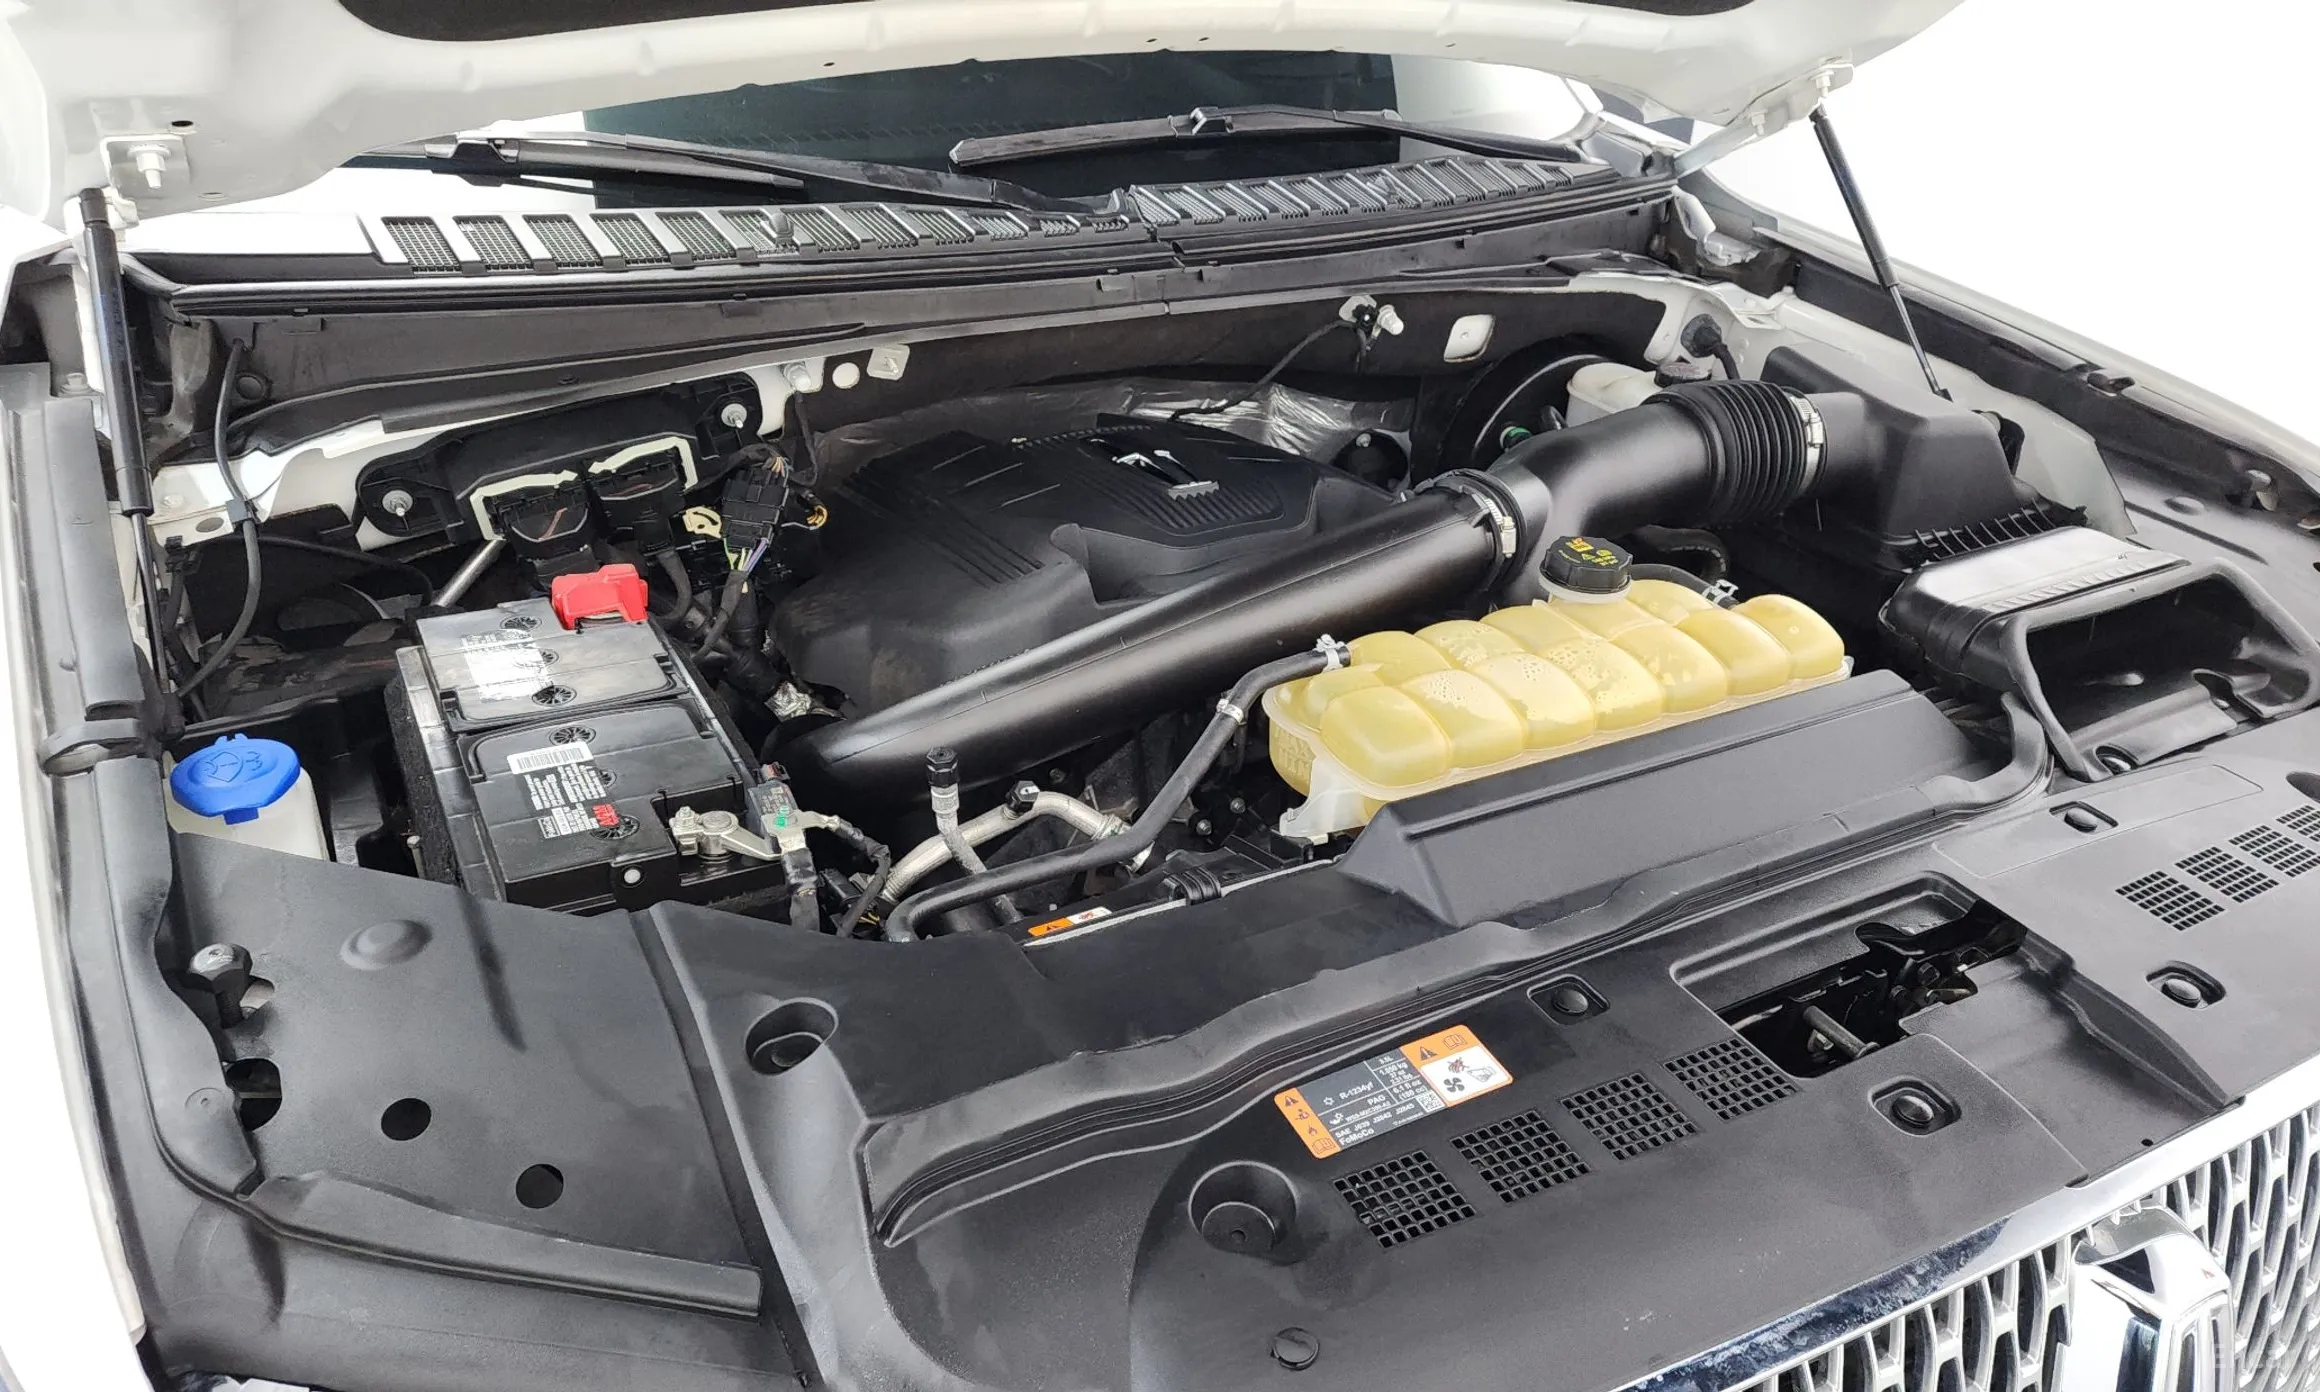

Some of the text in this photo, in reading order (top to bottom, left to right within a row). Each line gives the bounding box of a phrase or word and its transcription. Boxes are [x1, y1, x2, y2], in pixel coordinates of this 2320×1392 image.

[1396, 1062, 1408, 1070] kg
[1339, 1081, 1374, 1100] R-1234yf
[1367, 1094, 1386, 1105] PAG
[1335, 1128, 1351, 1138] SAE
[1339, 1128, 1375, 1145] FoMoCo
